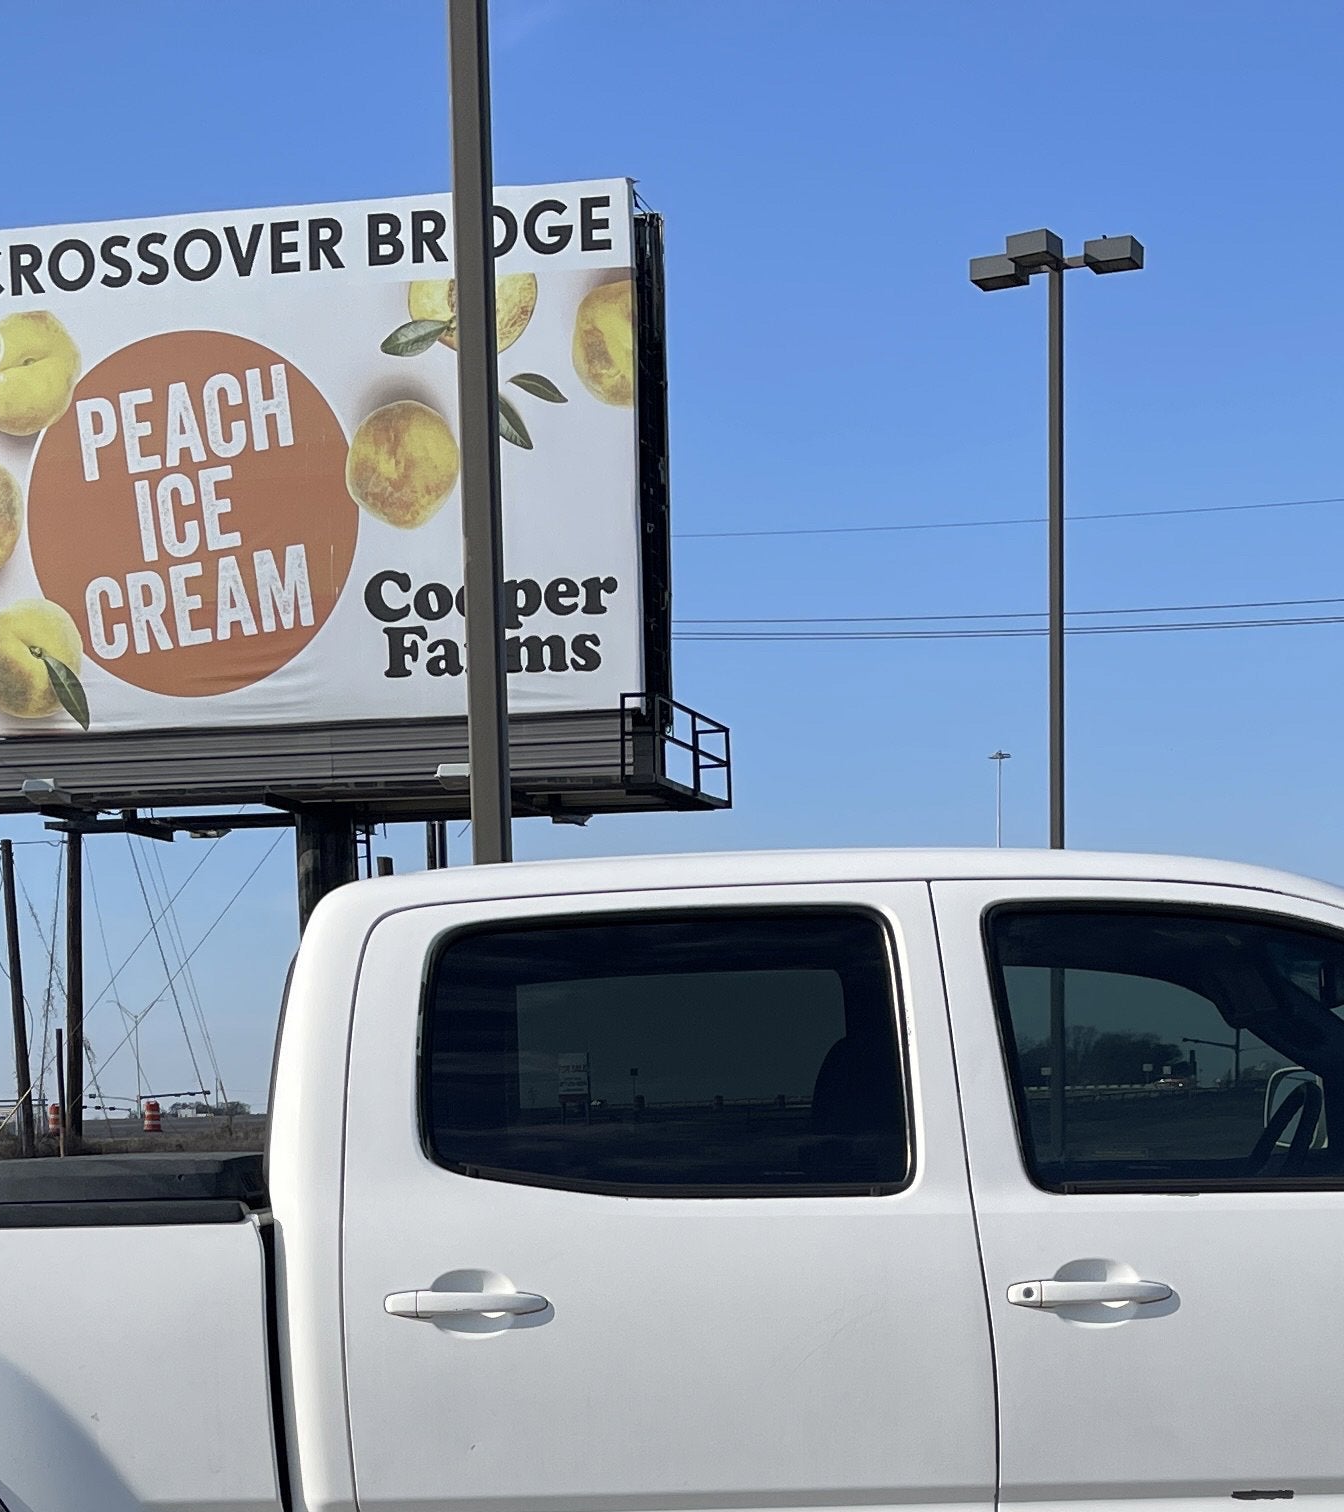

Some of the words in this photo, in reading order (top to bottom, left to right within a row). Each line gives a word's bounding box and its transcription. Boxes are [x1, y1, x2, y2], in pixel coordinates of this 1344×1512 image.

[367, 195, 612, 267] BRDGE
[76, 362, 296, 482] PEACH
[133, 465, 242, 563] ICE
[84, 543, 316, 661] CREAM
[364, 570, 618, 630] Coper
[382, 625, 602, 679] Fams
